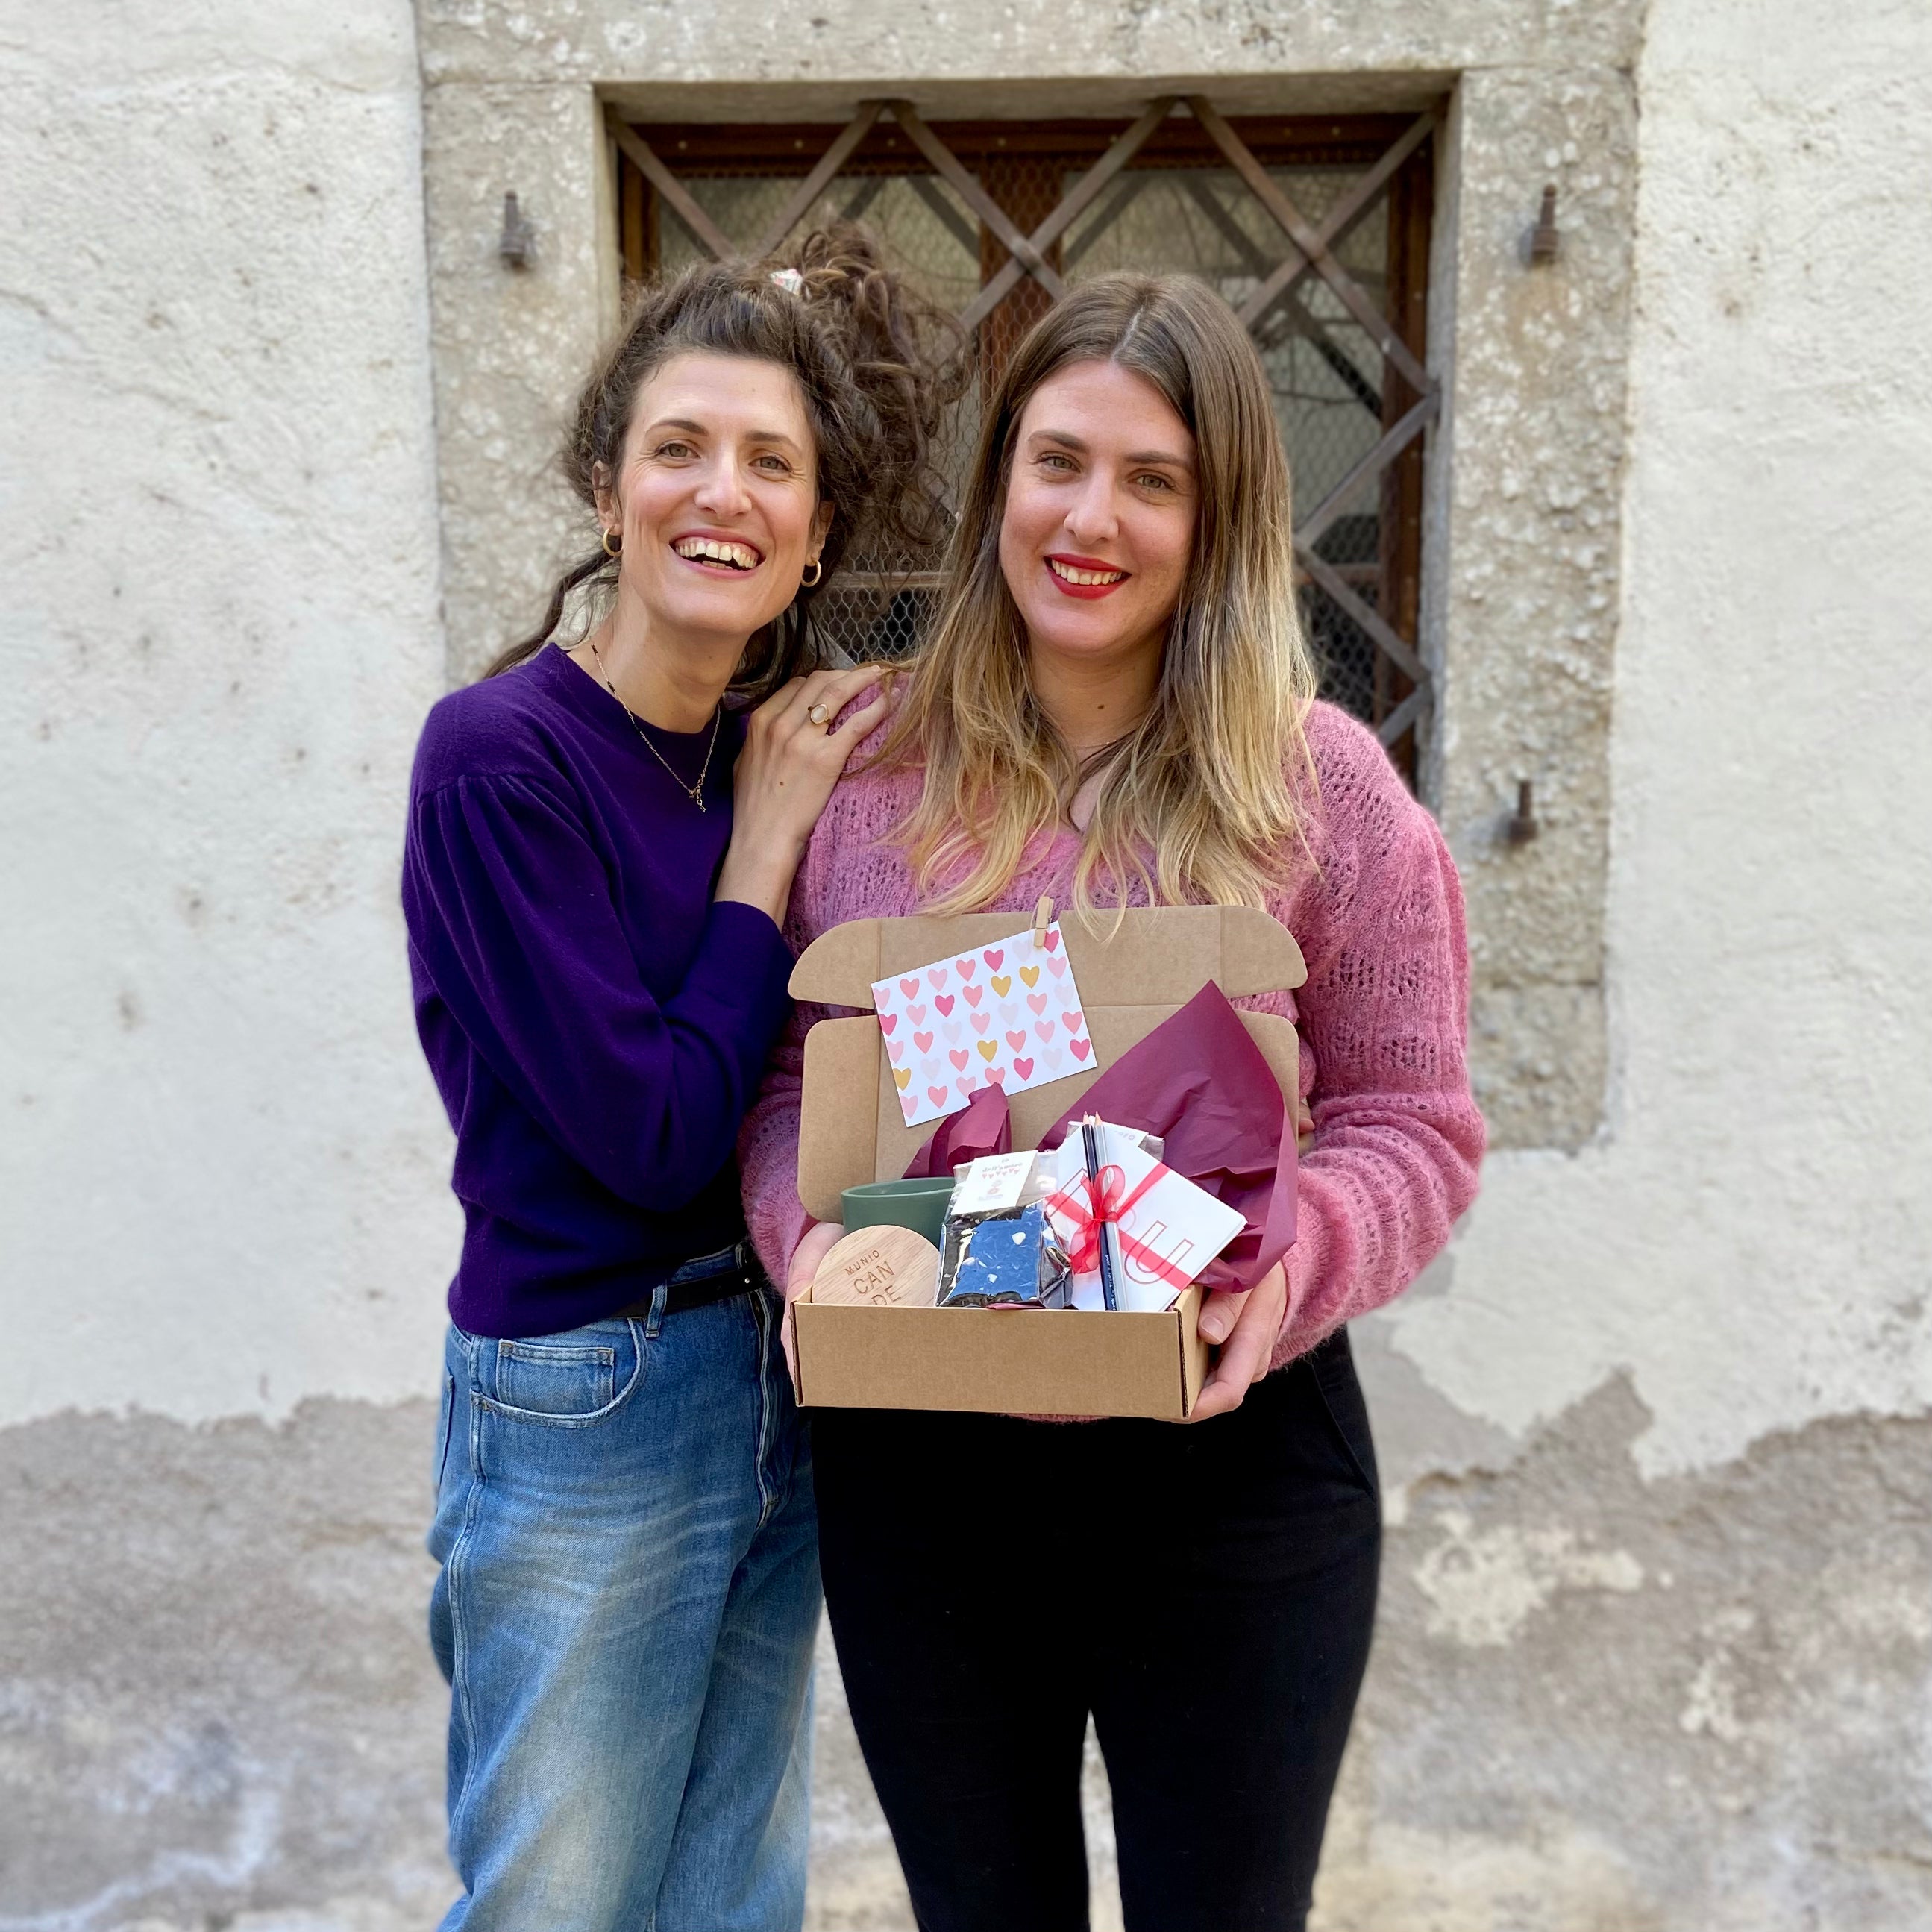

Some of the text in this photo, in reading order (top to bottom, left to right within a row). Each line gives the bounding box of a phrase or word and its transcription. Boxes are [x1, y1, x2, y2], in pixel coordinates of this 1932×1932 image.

[844, 1249, 880, 1276] MUNIO
[1124, 1220, 1195, 1285] U
[853, 1261, 895, 1295] CAN
